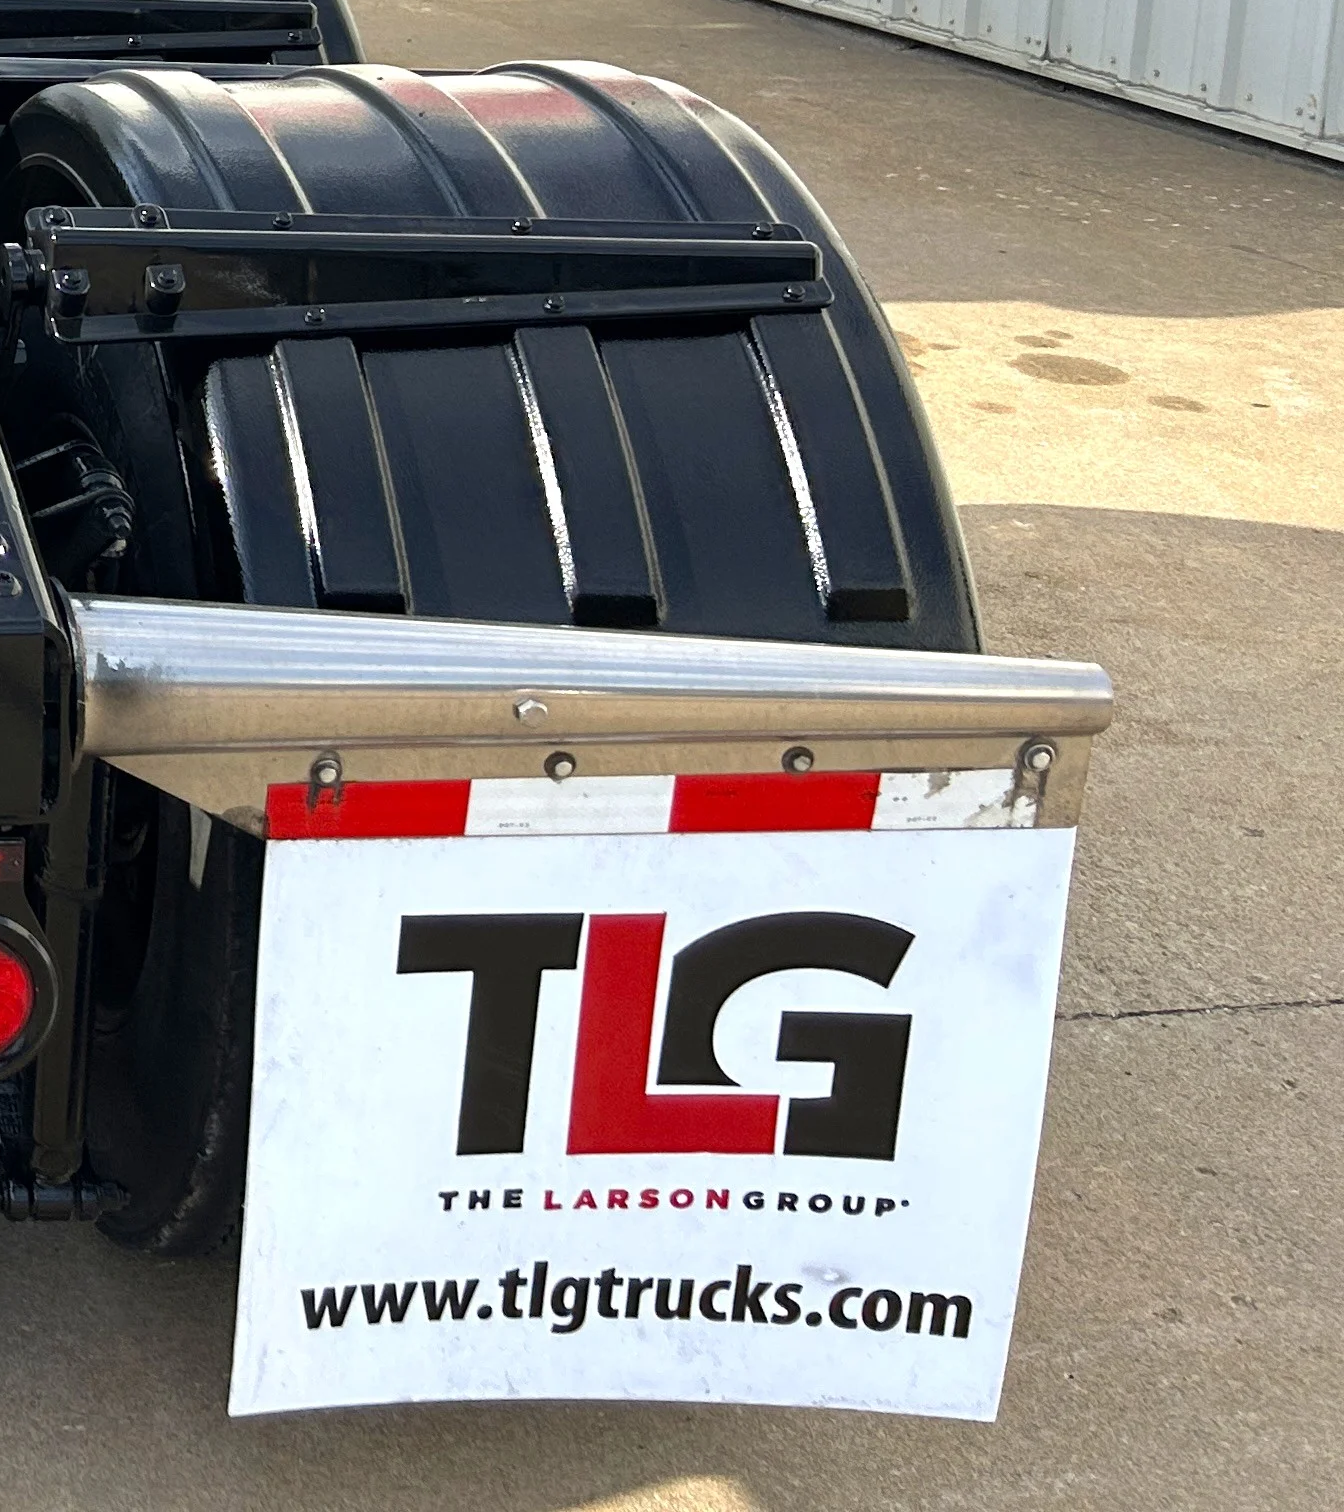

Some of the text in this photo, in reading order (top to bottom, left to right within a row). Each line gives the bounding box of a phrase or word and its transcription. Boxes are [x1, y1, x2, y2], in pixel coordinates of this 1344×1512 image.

[395, 910, 916, 1162] TLG
[438, 1188, 525, 1211] THE
[299, 1261, 973, 1340] www.tlgtrucks.com
